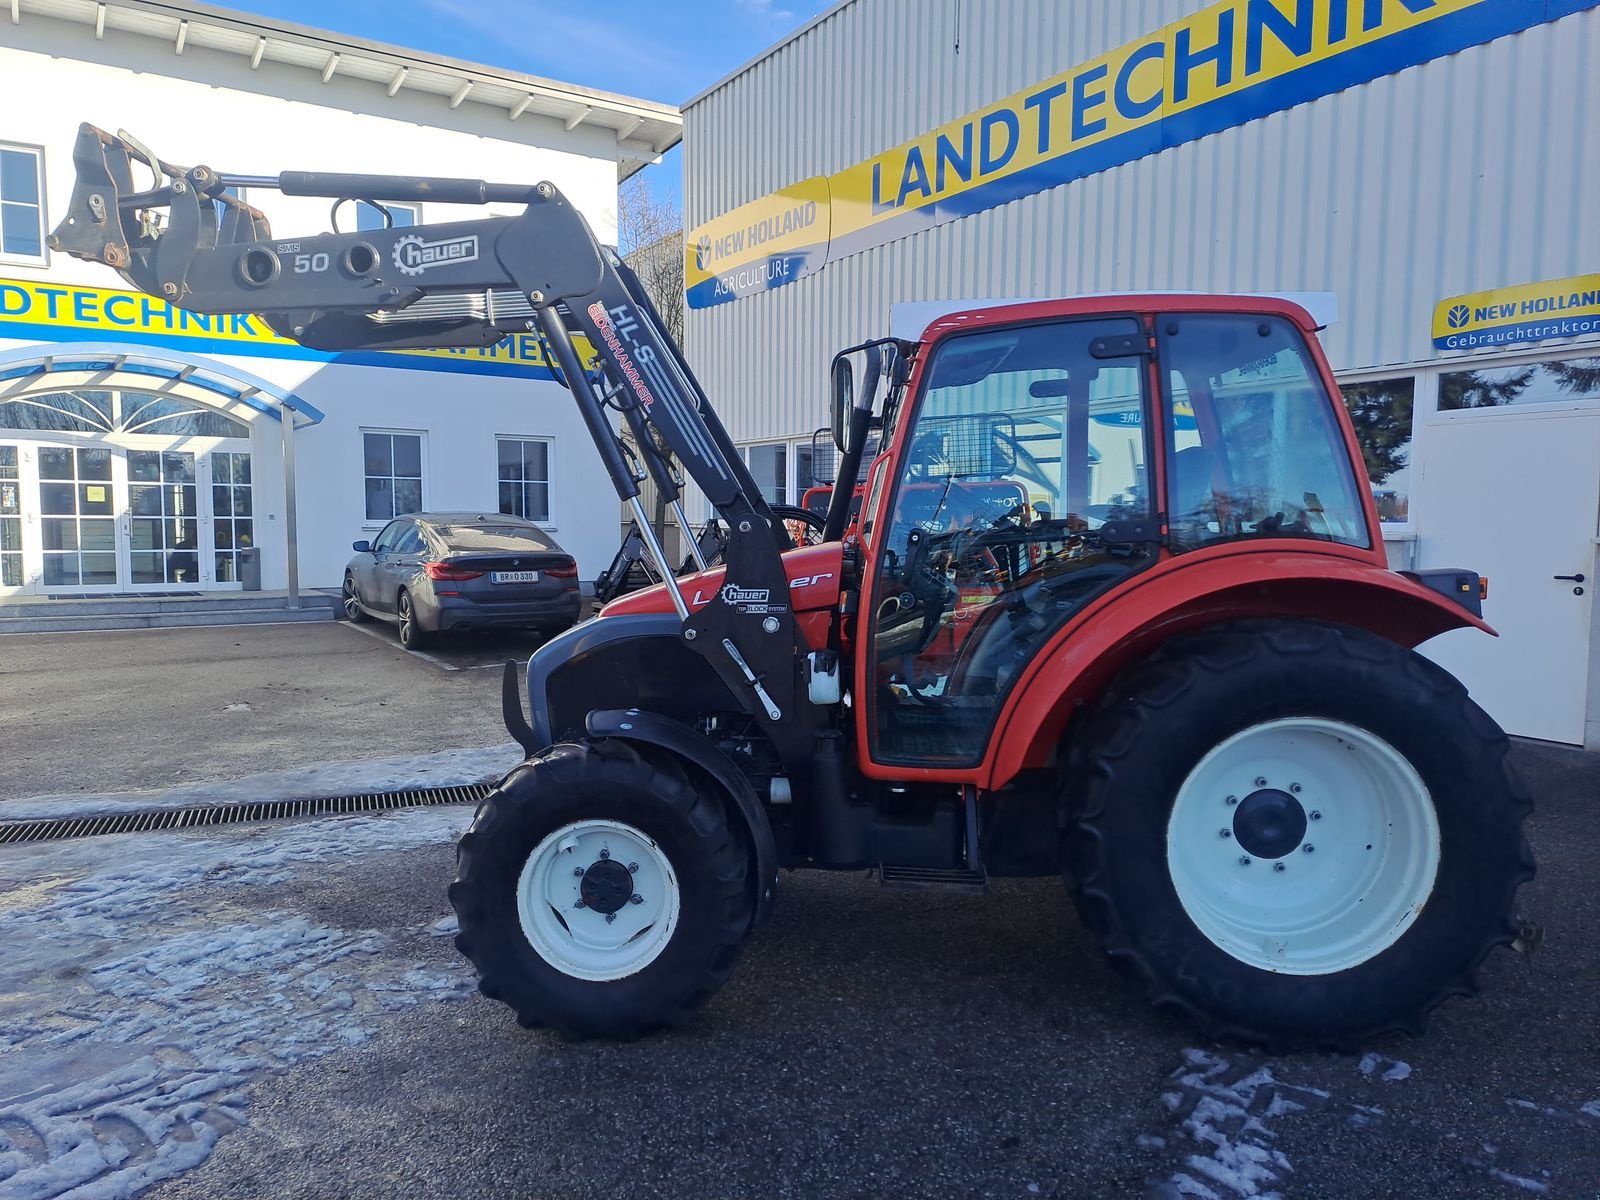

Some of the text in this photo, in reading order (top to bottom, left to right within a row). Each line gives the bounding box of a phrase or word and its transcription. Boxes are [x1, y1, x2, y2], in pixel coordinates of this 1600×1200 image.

[714, 200, 816, 260] NEW HOLLAND
[293, 252, 330, 273] 50
[405, 240, 473, 266] hauer
[713, 257, 790, 297] AGRICULTURE
[1474, 302, 1517, 321] NEW
[608, 303, 657, 364] HL-S
[587, 303, 654, 410] EIDENHAMMER
[728, 588, 767, 601] hauer
